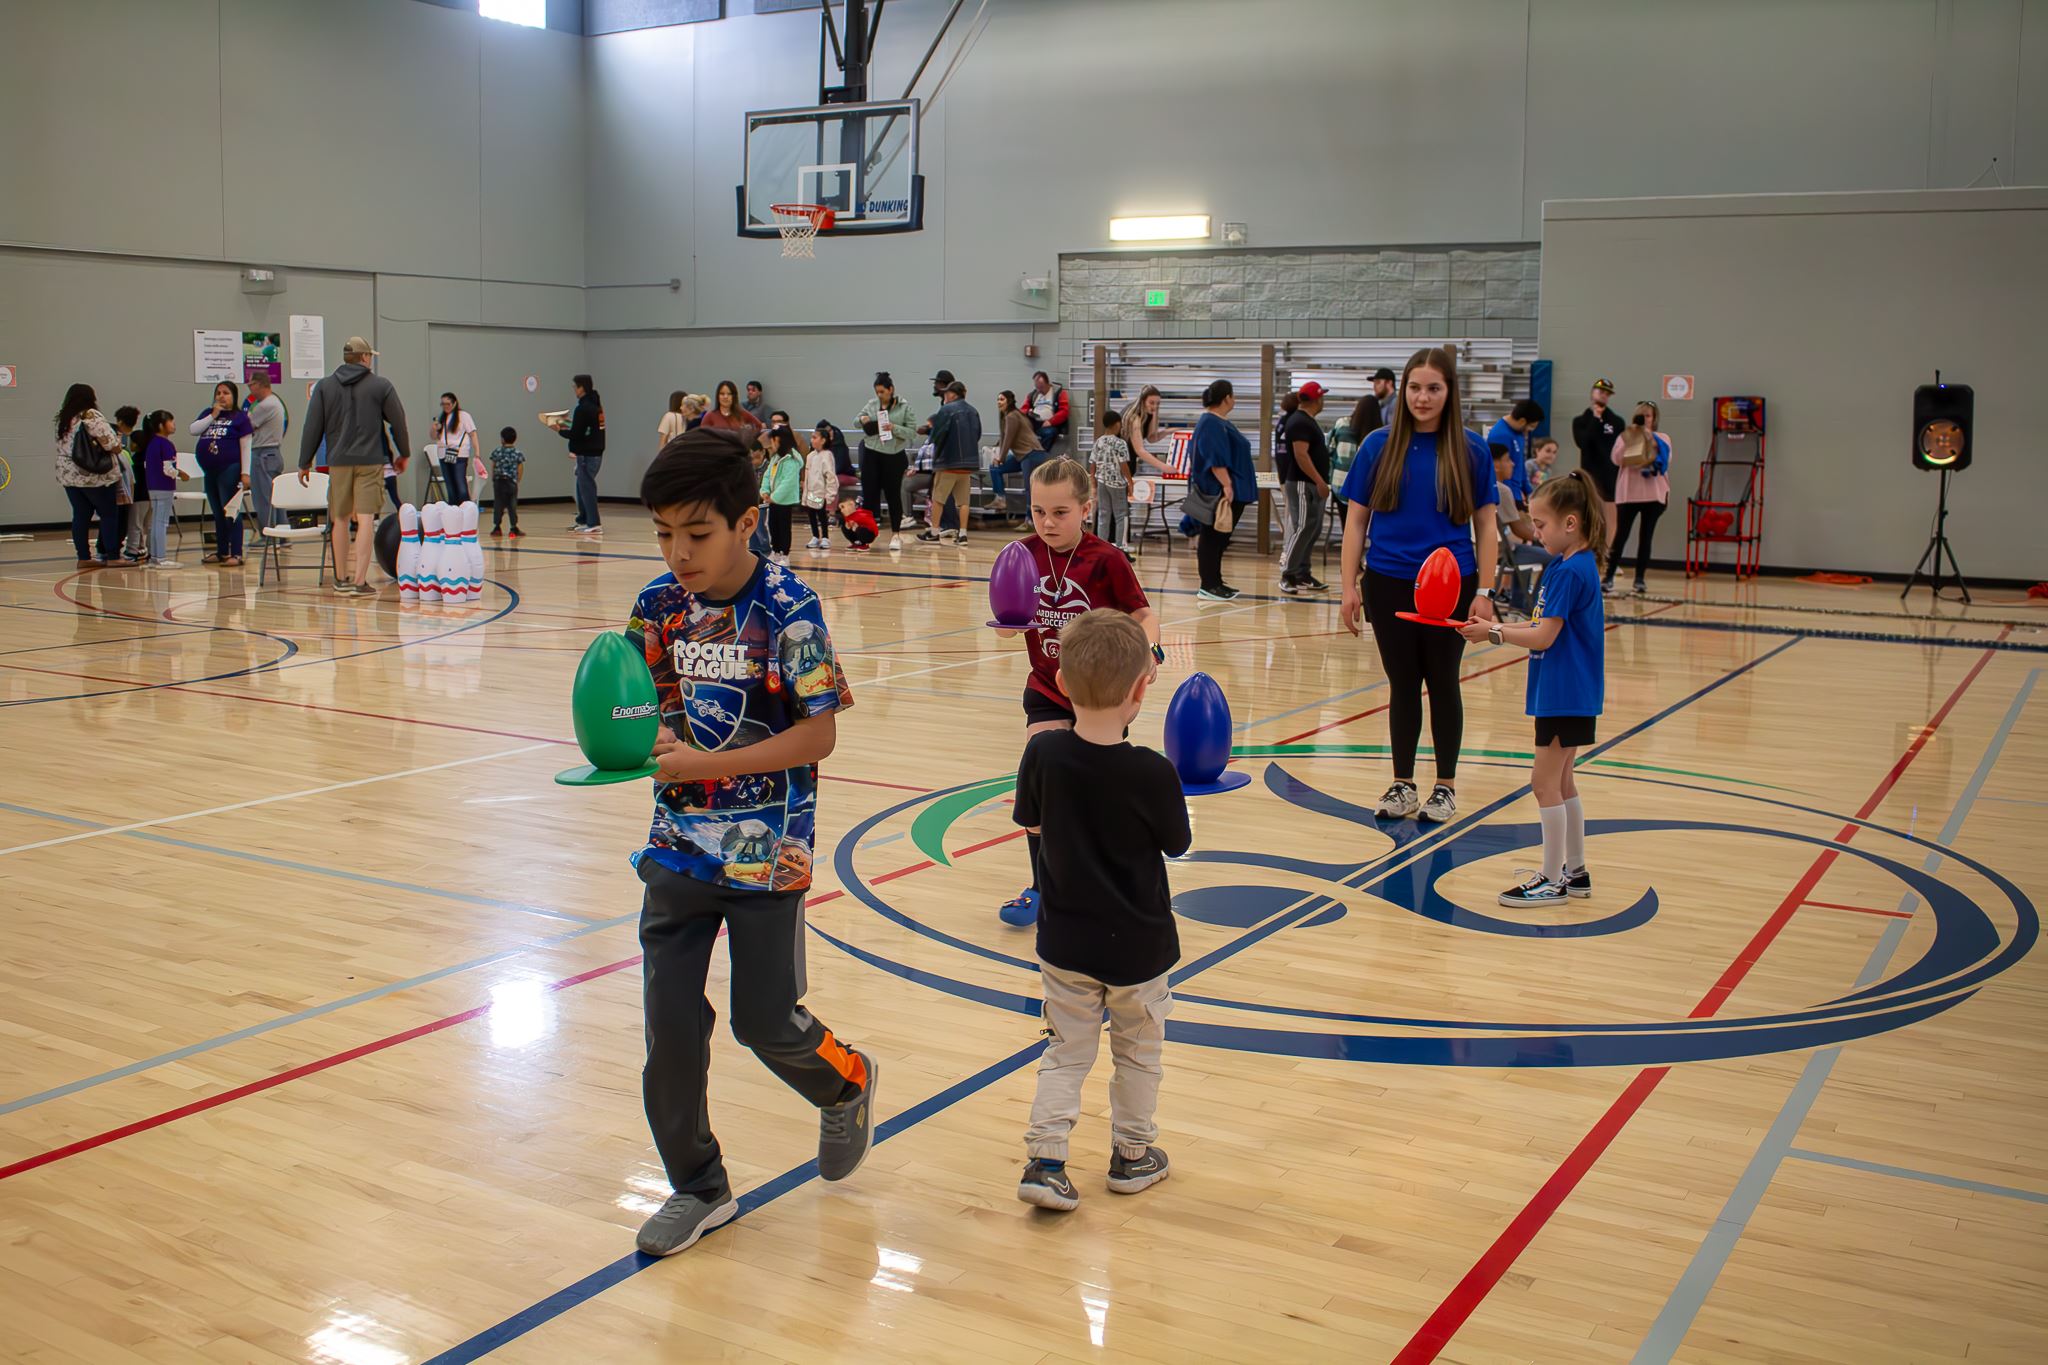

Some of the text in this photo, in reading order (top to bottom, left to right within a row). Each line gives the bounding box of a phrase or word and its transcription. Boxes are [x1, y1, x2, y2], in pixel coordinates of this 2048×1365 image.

[869, 199, 909, 213] DUNKING
[1036, 609, 1060, 619] ARDEN
[673, 639, 749, 663] ROCKET
[673, 656, 749, 680] LEAGUE
